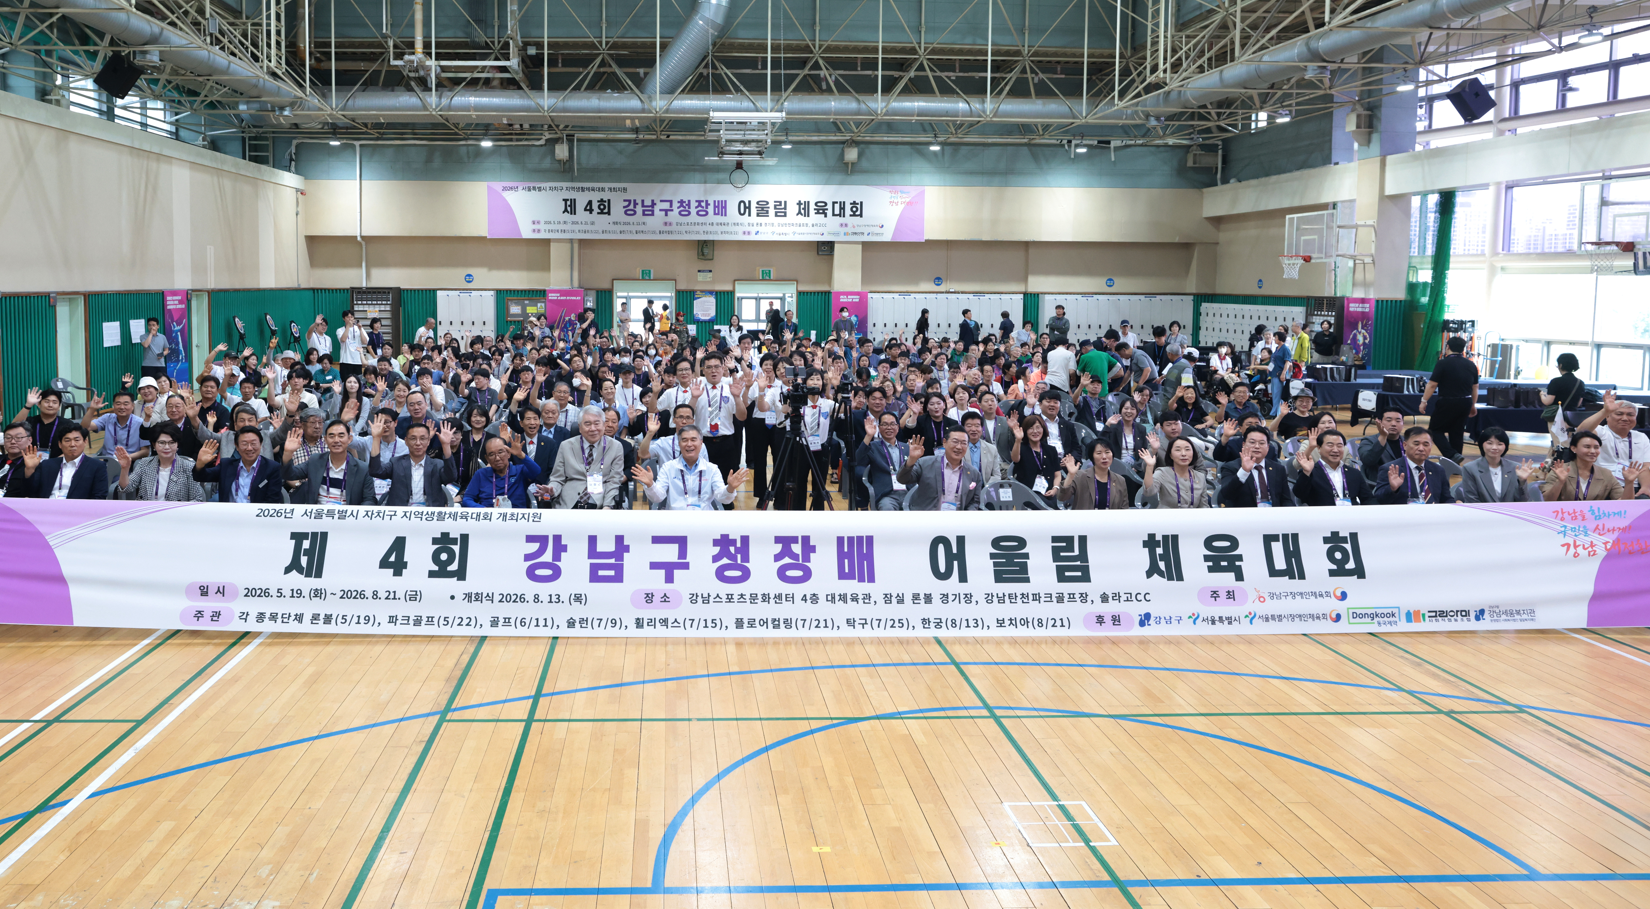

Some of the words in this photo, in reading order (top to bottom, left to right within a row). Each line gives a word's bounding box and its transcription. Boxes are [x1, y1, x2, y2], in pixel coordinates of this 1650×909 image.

[548, 185, 564, 193] 자치구
[562, 198, 577, 216] 제
[583, 198, 611, 216] 4회
[622, 198, 728, 217] 강남구청장배
[737, 199, 788, 218] 어울림
[795, 199, 865, 219] 체육대회
[255, 507, 295, 521] 2026년
[300, 507, 360, 522] 서울특별시
[362, 508, 398, 523] 자치구
[400, 508, 493, 523] 지역생활체육대회
[495, 509, 544, 524] 개최지원
[1552, 508, 1588, 522] 강남을
[1587, 505, 1627, 521] 힘차게!
[1557, 525, 1590, 539] 구민을
[1592, 523, 1632, 537] 신나게!
[1560, 539, 1598, 558] 강남
[283, 531, 328, 578] 제
[524, 534, 875, 584] 강남구청장배
[929, 535, 1091, 583] 어울림
[1142, 531, 1366, 582] 체육대회
[244, 587, 273, 598] 2026.
[276, 588, 286, 598] 5.
[289, 589, 305, 598] 19.
[309, 588, 327, 601] (화)
[339, 589, 368, 600] 2026.
[372, 590, 381, 600] 8.
[384, 590, 401, 600] 21.
[404, 590, 422, 603] (금)
[462, 592, 494, 604] 개회식
[498, 593, 529, 603] 2026.
[533, 594, 543, 603] 8.
[548, 594, 564, 603] 13.
[569, 593, 587, 606] (목)
[689, 593, 794, 604] 강남스포츠문화센터
[801, 593, 819, 604] 4층
[826, 593, 877, 605] 대체육관,
[883, 593, 905, 604] 잠실
[911, 593, 933, 604] 론볼
[940, 593, 978, 605] 경기장,
[984, 592, 1094, 605] 강남탄천파크골프장,
[1100, 592, 1151, 603] 솔라고CC
[1267, 589, 1333, 600] 강남구장애인체육회
[1152, 614, 1184, 626] 강남구
[1256, 611, 1329, 624] 서울특별시장애인체육회
[1351, 610, 1397, 621] Dongkook
[1487, 608, 1536, 618] 강남세움복지관
[238, 611, 250, 623] 각
[255, 612, 304, 624] 종목단체
[310, 613, 381, 627] 론볼(5/19),
[387, 615, 483, 629] 파크골프(5/22),
[490, 616, 559, 629] 골프(6/11),
[734, 618, 840, 630] 플로어컬링(7/21),
[846, 618, 915, 630] 탁구(7/25),
[996, 617, 1070, 629] 보치아(8/21)
[1200, 615, 1242, 626] 서울특별시
